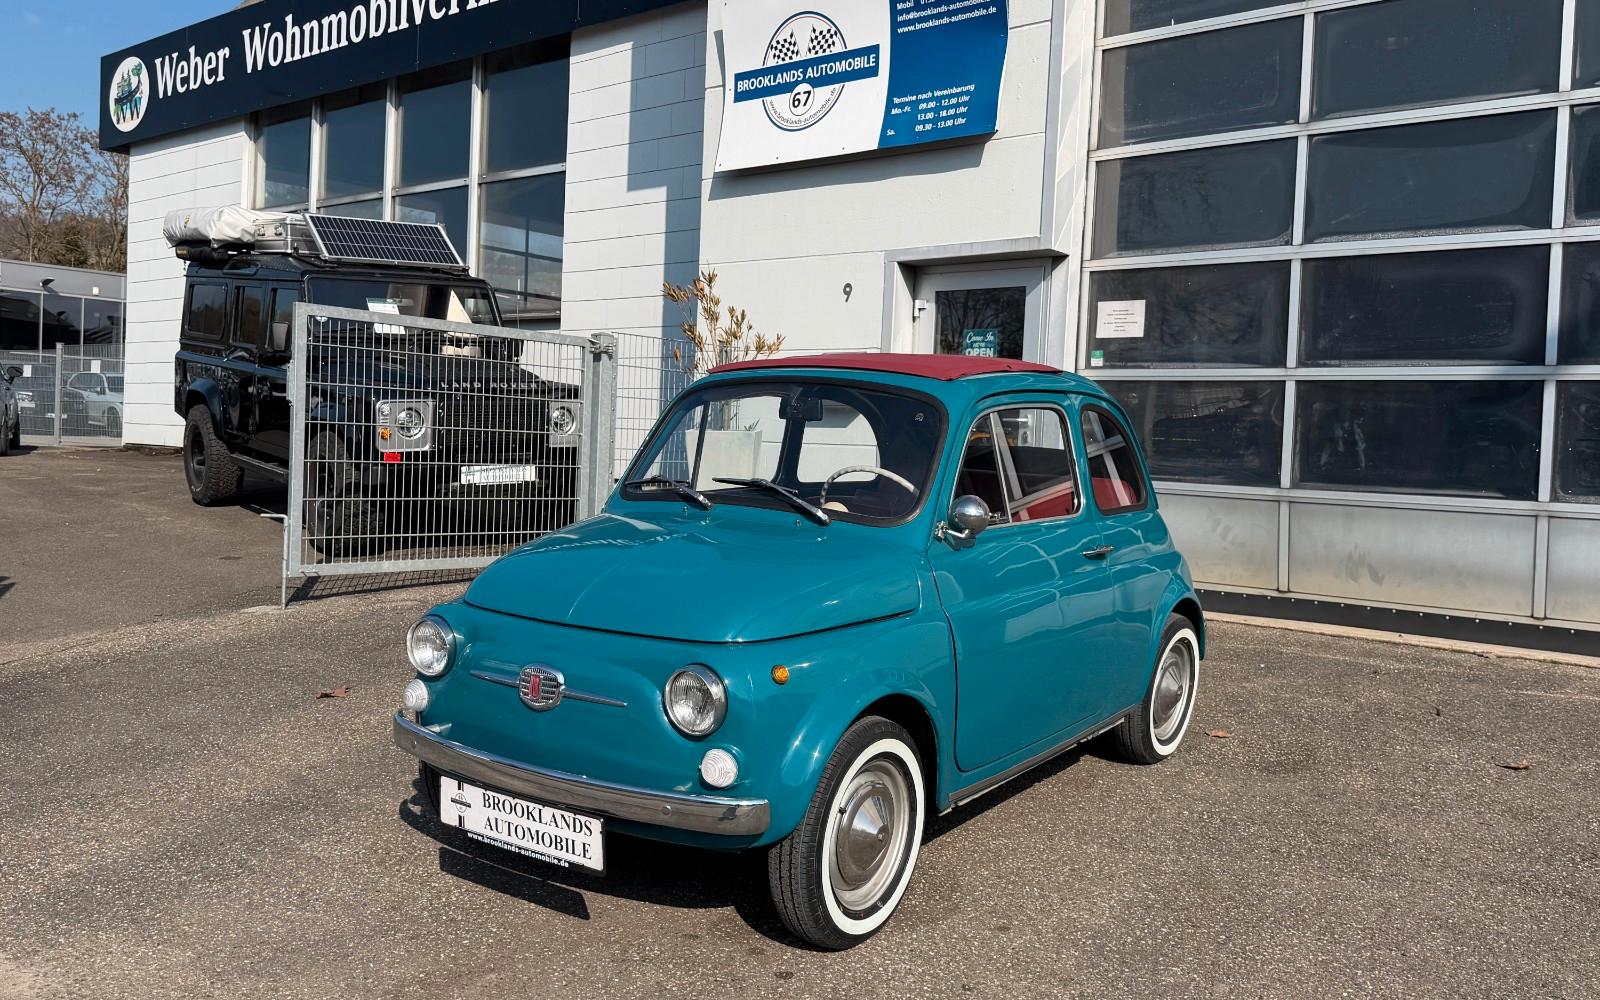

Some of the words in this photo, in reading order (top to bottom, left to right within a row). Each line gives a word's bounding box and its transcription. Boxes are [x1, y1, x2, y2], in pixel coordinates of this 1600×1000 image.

[897, 0, 914, 10] Mobil
[898, 0, 991, 22] info@brooklands-automobi.
[897, 6, 997, 34] www.brooklands-automobile.de
[154, 45, 230, 99] Weber
[242, 0, 500, 73] Wohnmobilve
[737, 69, 803, 92] BROOKLANDS
[806, 54, 876, 79] AUTOMOBILE
[792, 90, 812, 109] 67
[893, 94, 916, 104] Termine
[918, 91, 932, 100] nach
[934, 84, 975, 98] Vereinbarung
[919, 101, 936, 110] 09.00
[941, 97, 957, 106] 12.00
[958, 95, 970, 103] Uhr
[917, 112, 934, 120] 13.00
[940, 108, 956, 117] 18.00
[956, 106, 968, 114] Uhr
[915, 123, 932, 132] 09.30
[937, 119, 954, 129] 13.00
[954, 117, 967, 126] Uhr
[842, 282, 853, 303] 9
[966, 331, 983, 343] Come
[984, 331, 994, 341] In
[965, 347, 994, 357] OPEN
[482, 792, 593, 837] BROOKLANDS
[484, 816, 592, 860] AUTOMOBILE
[467, 832, 569, 868] www.brooklands-automobile.de
